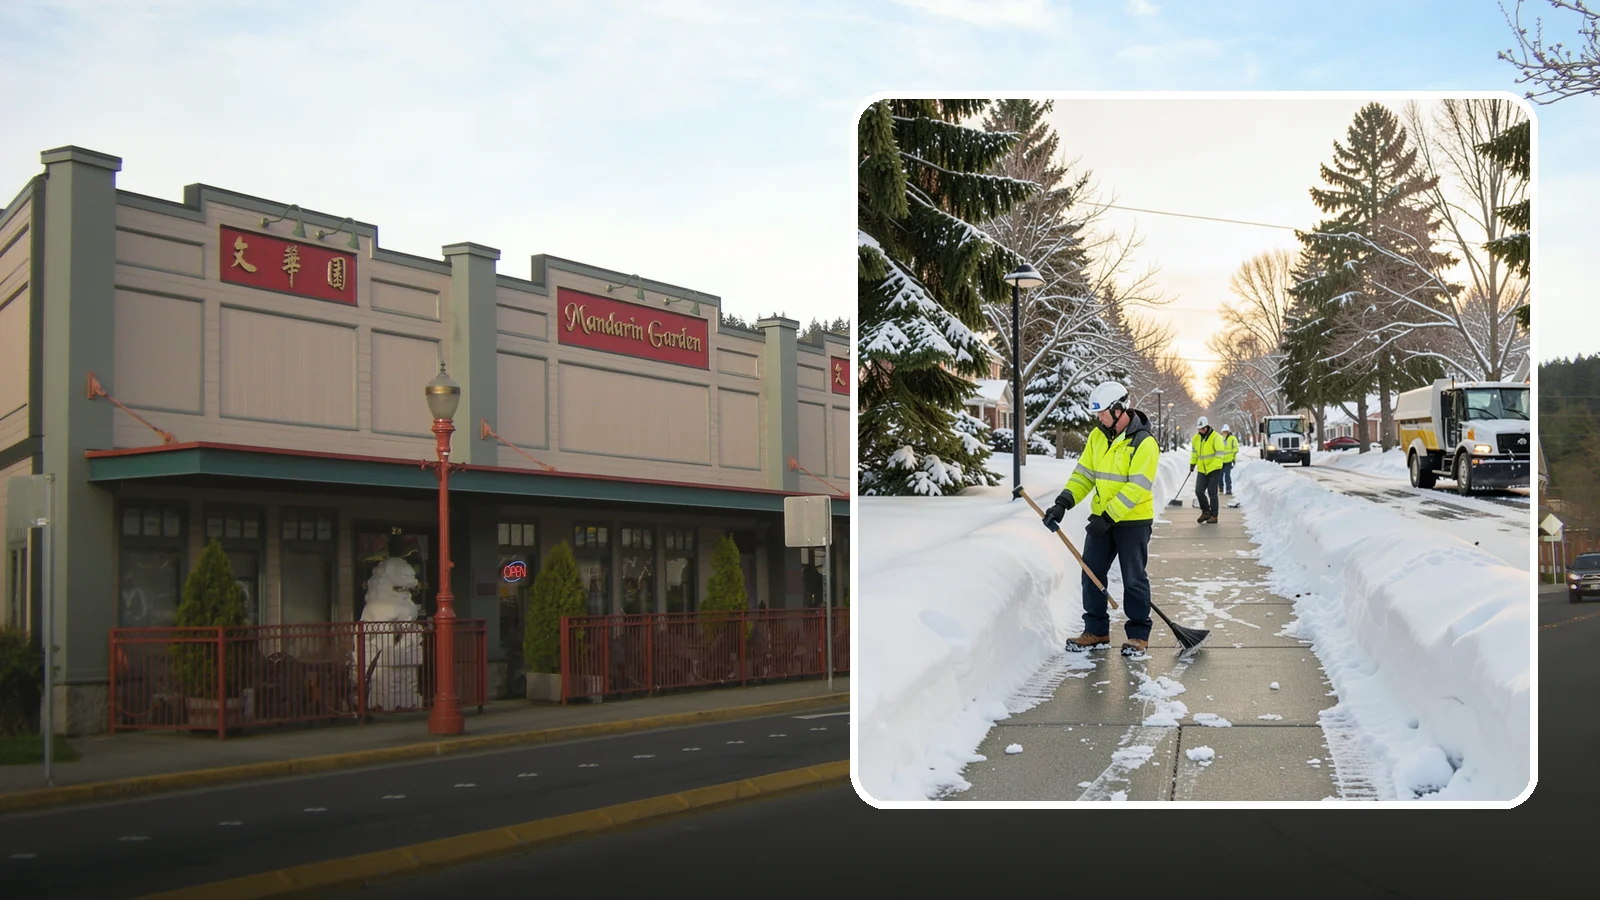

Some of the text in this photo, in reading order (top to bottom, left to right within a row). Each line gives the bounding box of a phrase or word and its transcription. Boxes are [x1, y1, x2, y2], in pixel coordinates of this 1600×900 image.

[230, 235, 346, 291] 文華園
[564, 302, 702, 352] Mandarin Garden
[503, 565, 527, 578] OPEN
